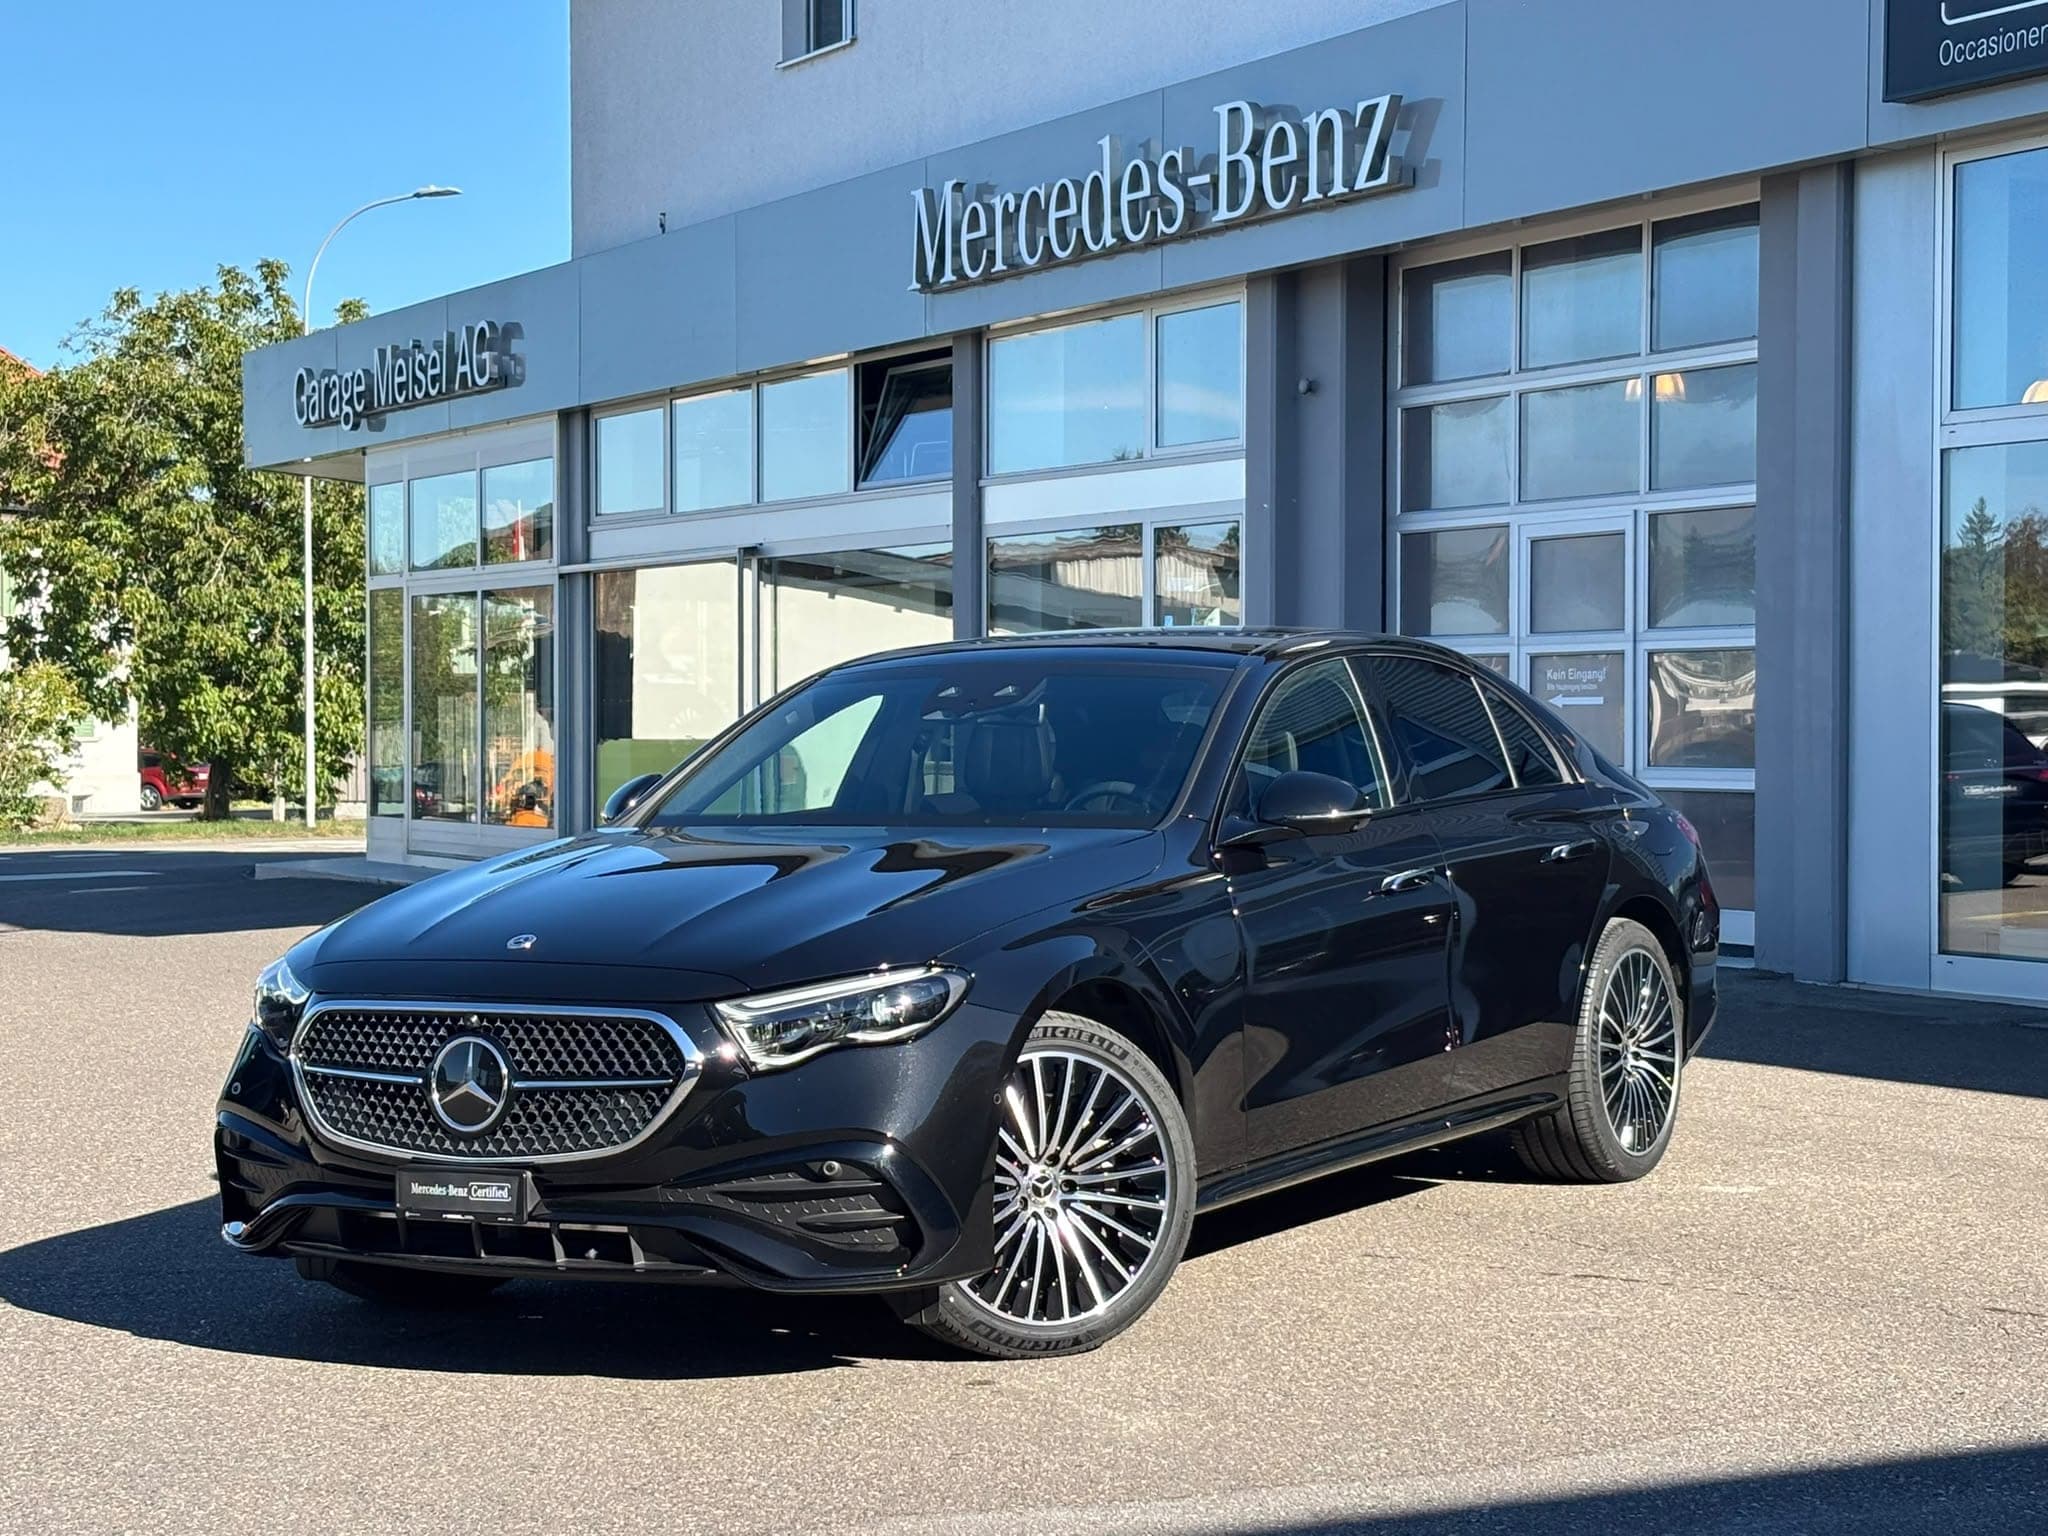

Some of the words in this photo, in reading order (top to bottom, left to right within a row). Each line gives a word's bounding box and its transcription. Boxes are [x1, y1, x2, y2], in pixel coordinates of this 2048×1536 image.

[908, 94, 1403, 292] Mercedes-Benz
[293, 367, 365, 431] Garage
[373, 331, 448, 408] Meisel
[455, 319, 491, 392] AG
[1546, 669, 1566, 681] Kein
[1029, 1026, 1124, 1057] MICHELIN
[410, 1182, 468, 1197] Mercedes-Benz
[471, 1185, 509, 1199] Certified
